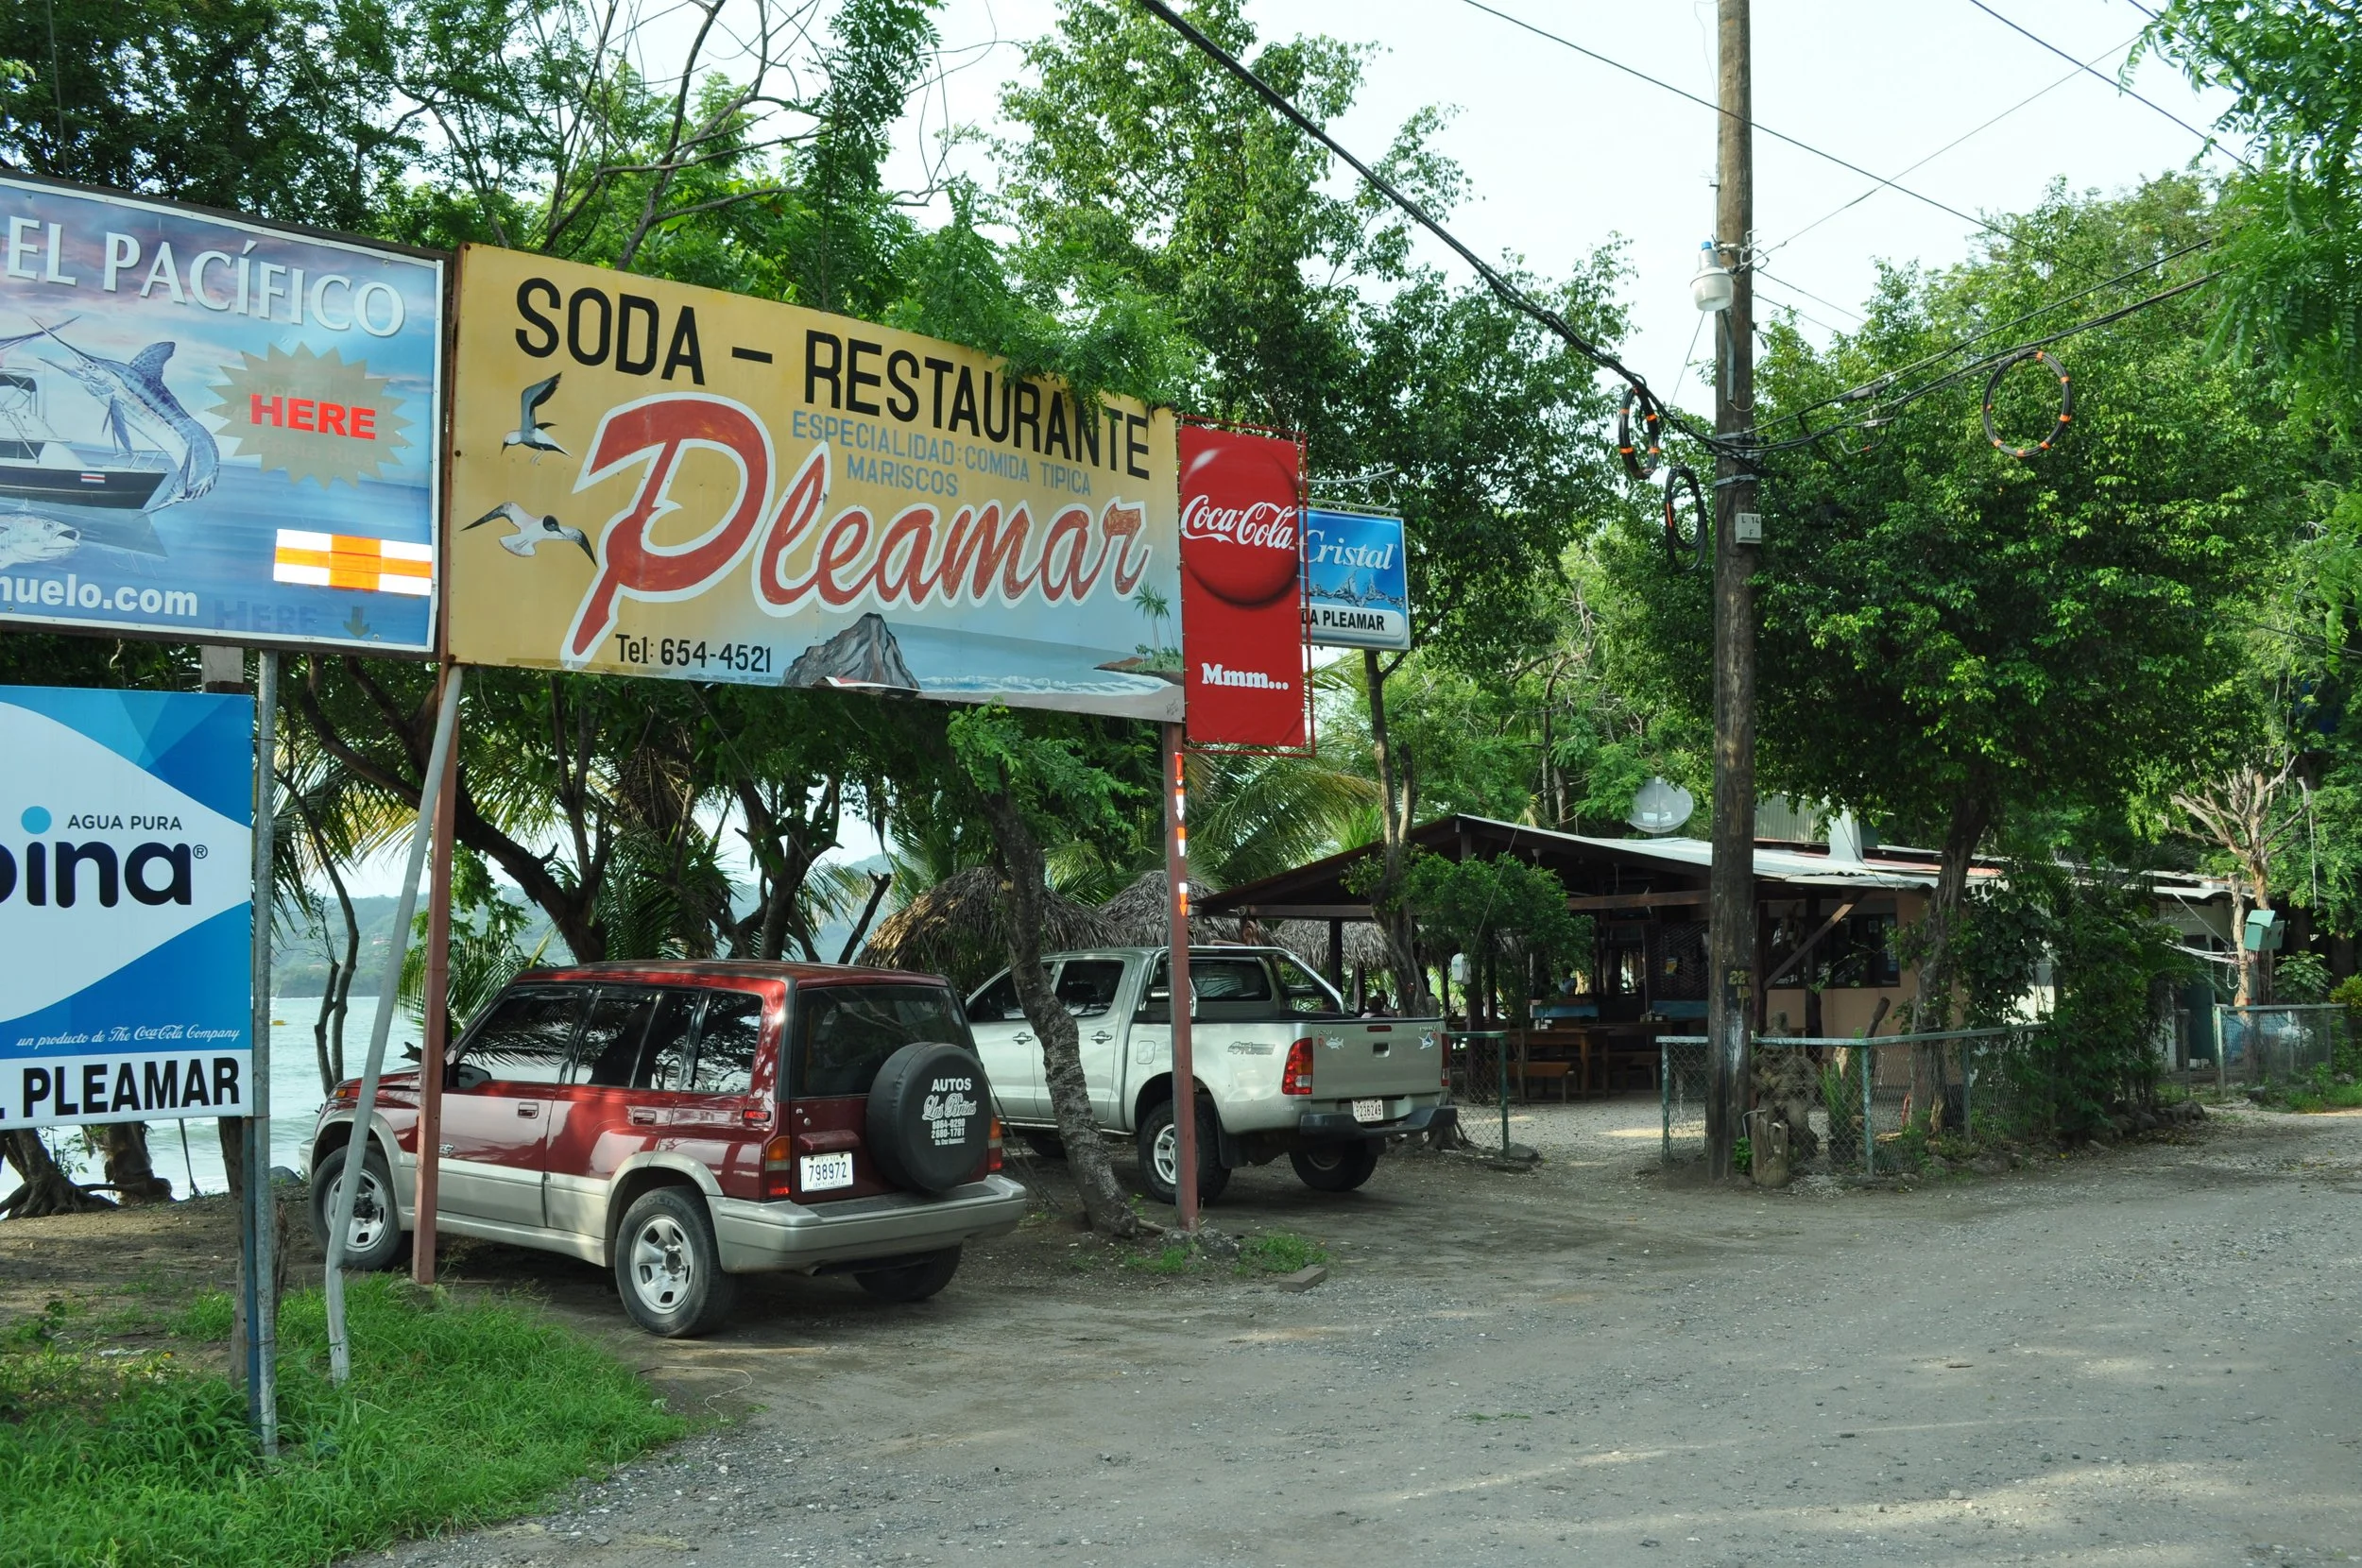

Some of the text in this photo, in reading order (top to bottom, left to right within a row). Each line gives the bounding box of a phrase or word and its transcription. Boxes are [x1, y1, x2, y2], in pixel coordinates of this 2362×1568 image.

[7, 215, 405, 337] EL PACÍFICO
[515, 277, 705, 386] SODA
[804, 329, 1150, 480] RESTAURANTE
[249, 393, 376, 440] HERE
[847, 453, 958, 497] MARISCOS
[1039, 461, 1091, 497] TIPICA
[561, 392, 1153, 668] Pleamar
[1181, 494, 1297, 549] Coca-Cola
[1299, 529, 1394, 570] Cristal
[1323, 609, 1385, 631] PLEAMAR
[615, 634, 771, 673] Tel: 654-4521
[1202, 663, 1289, 690] Mmm...
[67, 814, 182, 830] AGUA PURA
[0, 806, 192, 908] ina
[16, 1024, 240, 1049] un producto de The Coca-Cola Company
[23, 1057, 240, 1117] PLEAMAR
[932, 1078, 971, 1092] AUTOS
[809, 1161, 847, 1182] 798972
